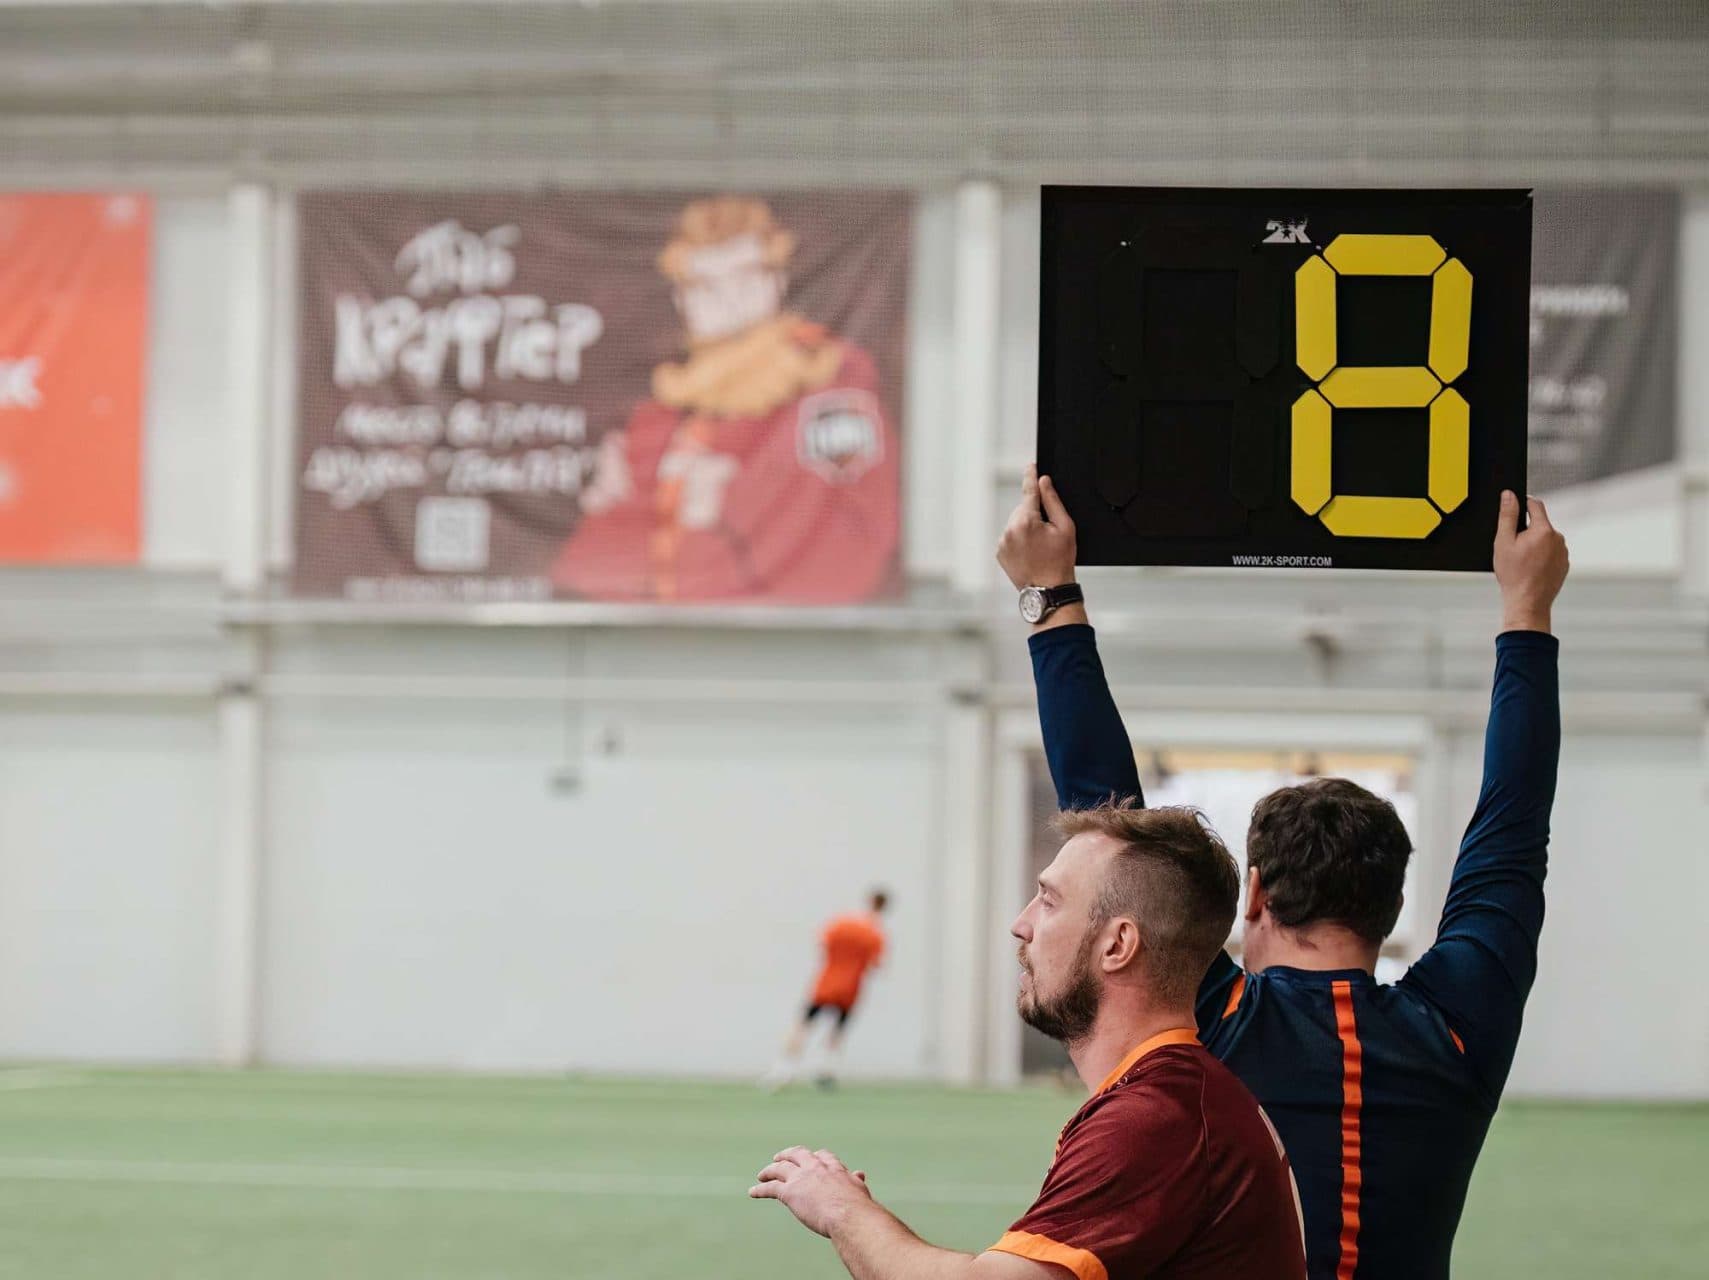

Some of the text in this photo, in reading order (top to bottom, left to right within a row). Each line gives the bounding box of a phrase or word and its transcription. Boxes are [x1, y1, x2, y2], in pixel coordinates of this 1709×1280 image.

[1262, 218, 1312, 243] 2K
[1291, 233, 1473, 539] 8
[1232, 555, 1332, 567] WWW.2K-SPORT.COM
